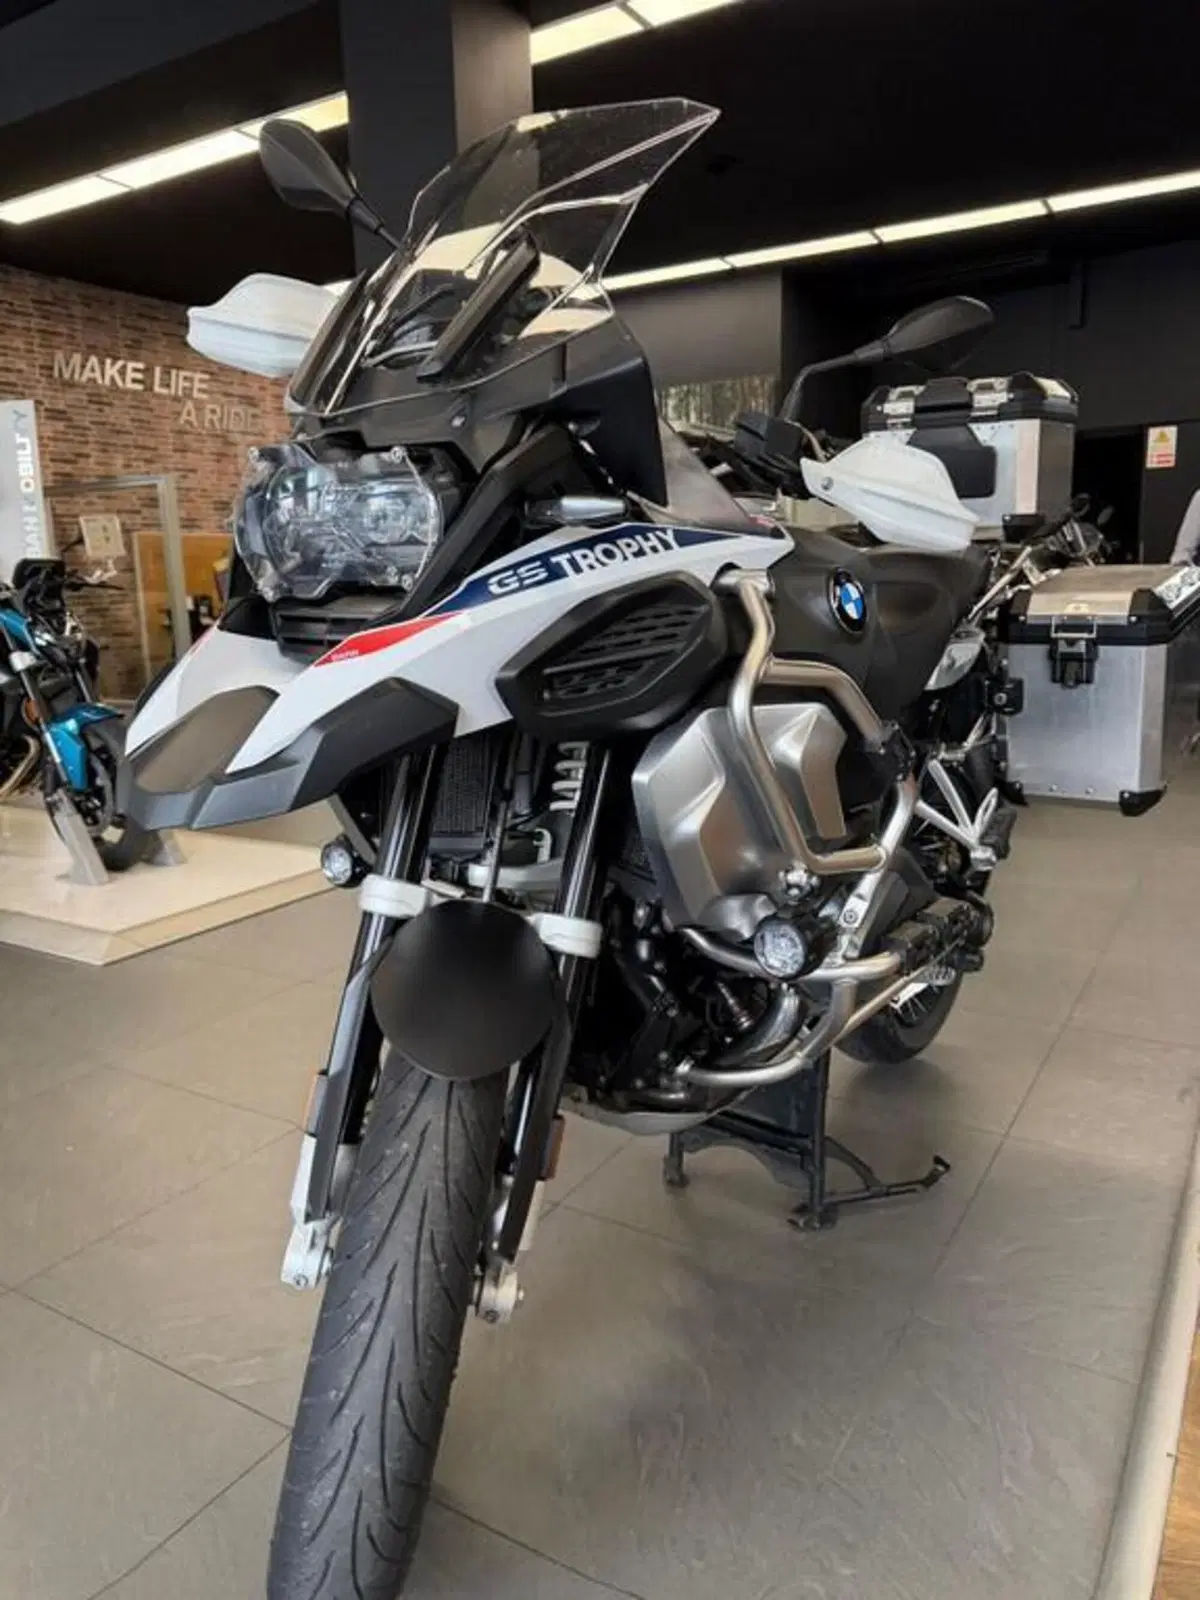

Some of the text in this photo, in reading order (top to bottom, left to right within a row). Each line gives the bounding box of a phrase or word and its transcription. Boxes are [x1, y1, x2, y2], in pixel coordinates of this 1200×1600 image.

[53, 352, 211, 399] MAKE LIFE
[179, 401, 199, 427] A
[487, 528, 680, 595] GS TROPHY
